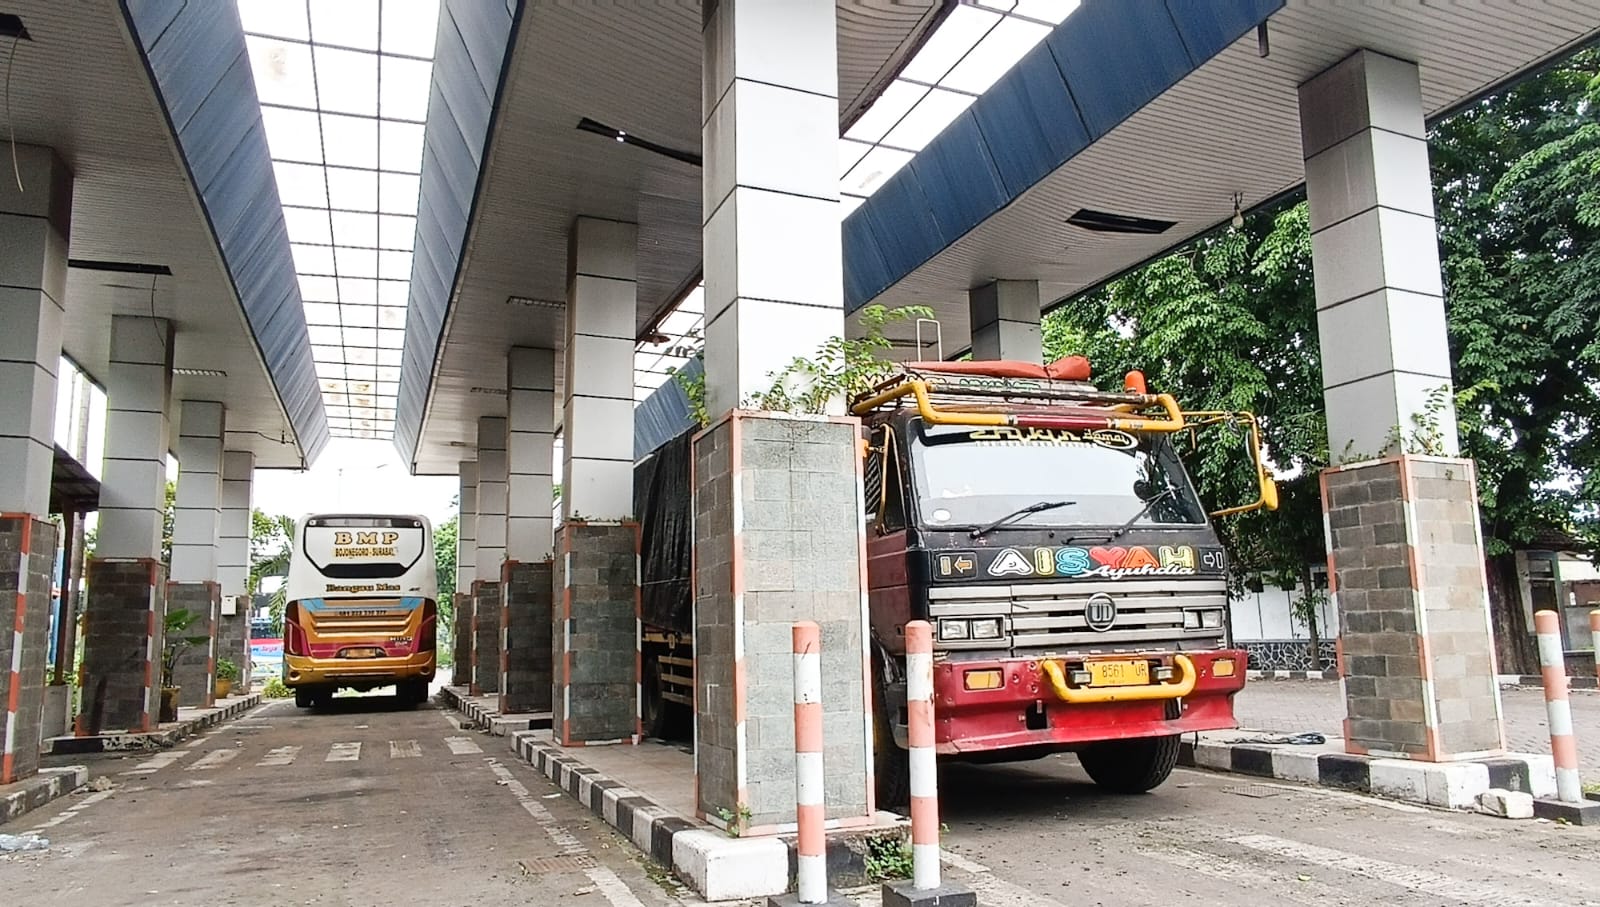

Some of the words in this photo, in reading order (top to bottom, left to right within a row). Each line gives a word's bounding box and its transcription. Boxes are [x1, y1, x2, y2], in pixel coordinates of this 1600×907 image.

[335, 531, 399, 545] BMP
[987, 546, 1194, 576] AISYAH
[376, 583, 401, 592] Mas
[1090, 602, 1112, 622] UD
[1101, 664, 1125, 678] 8561
